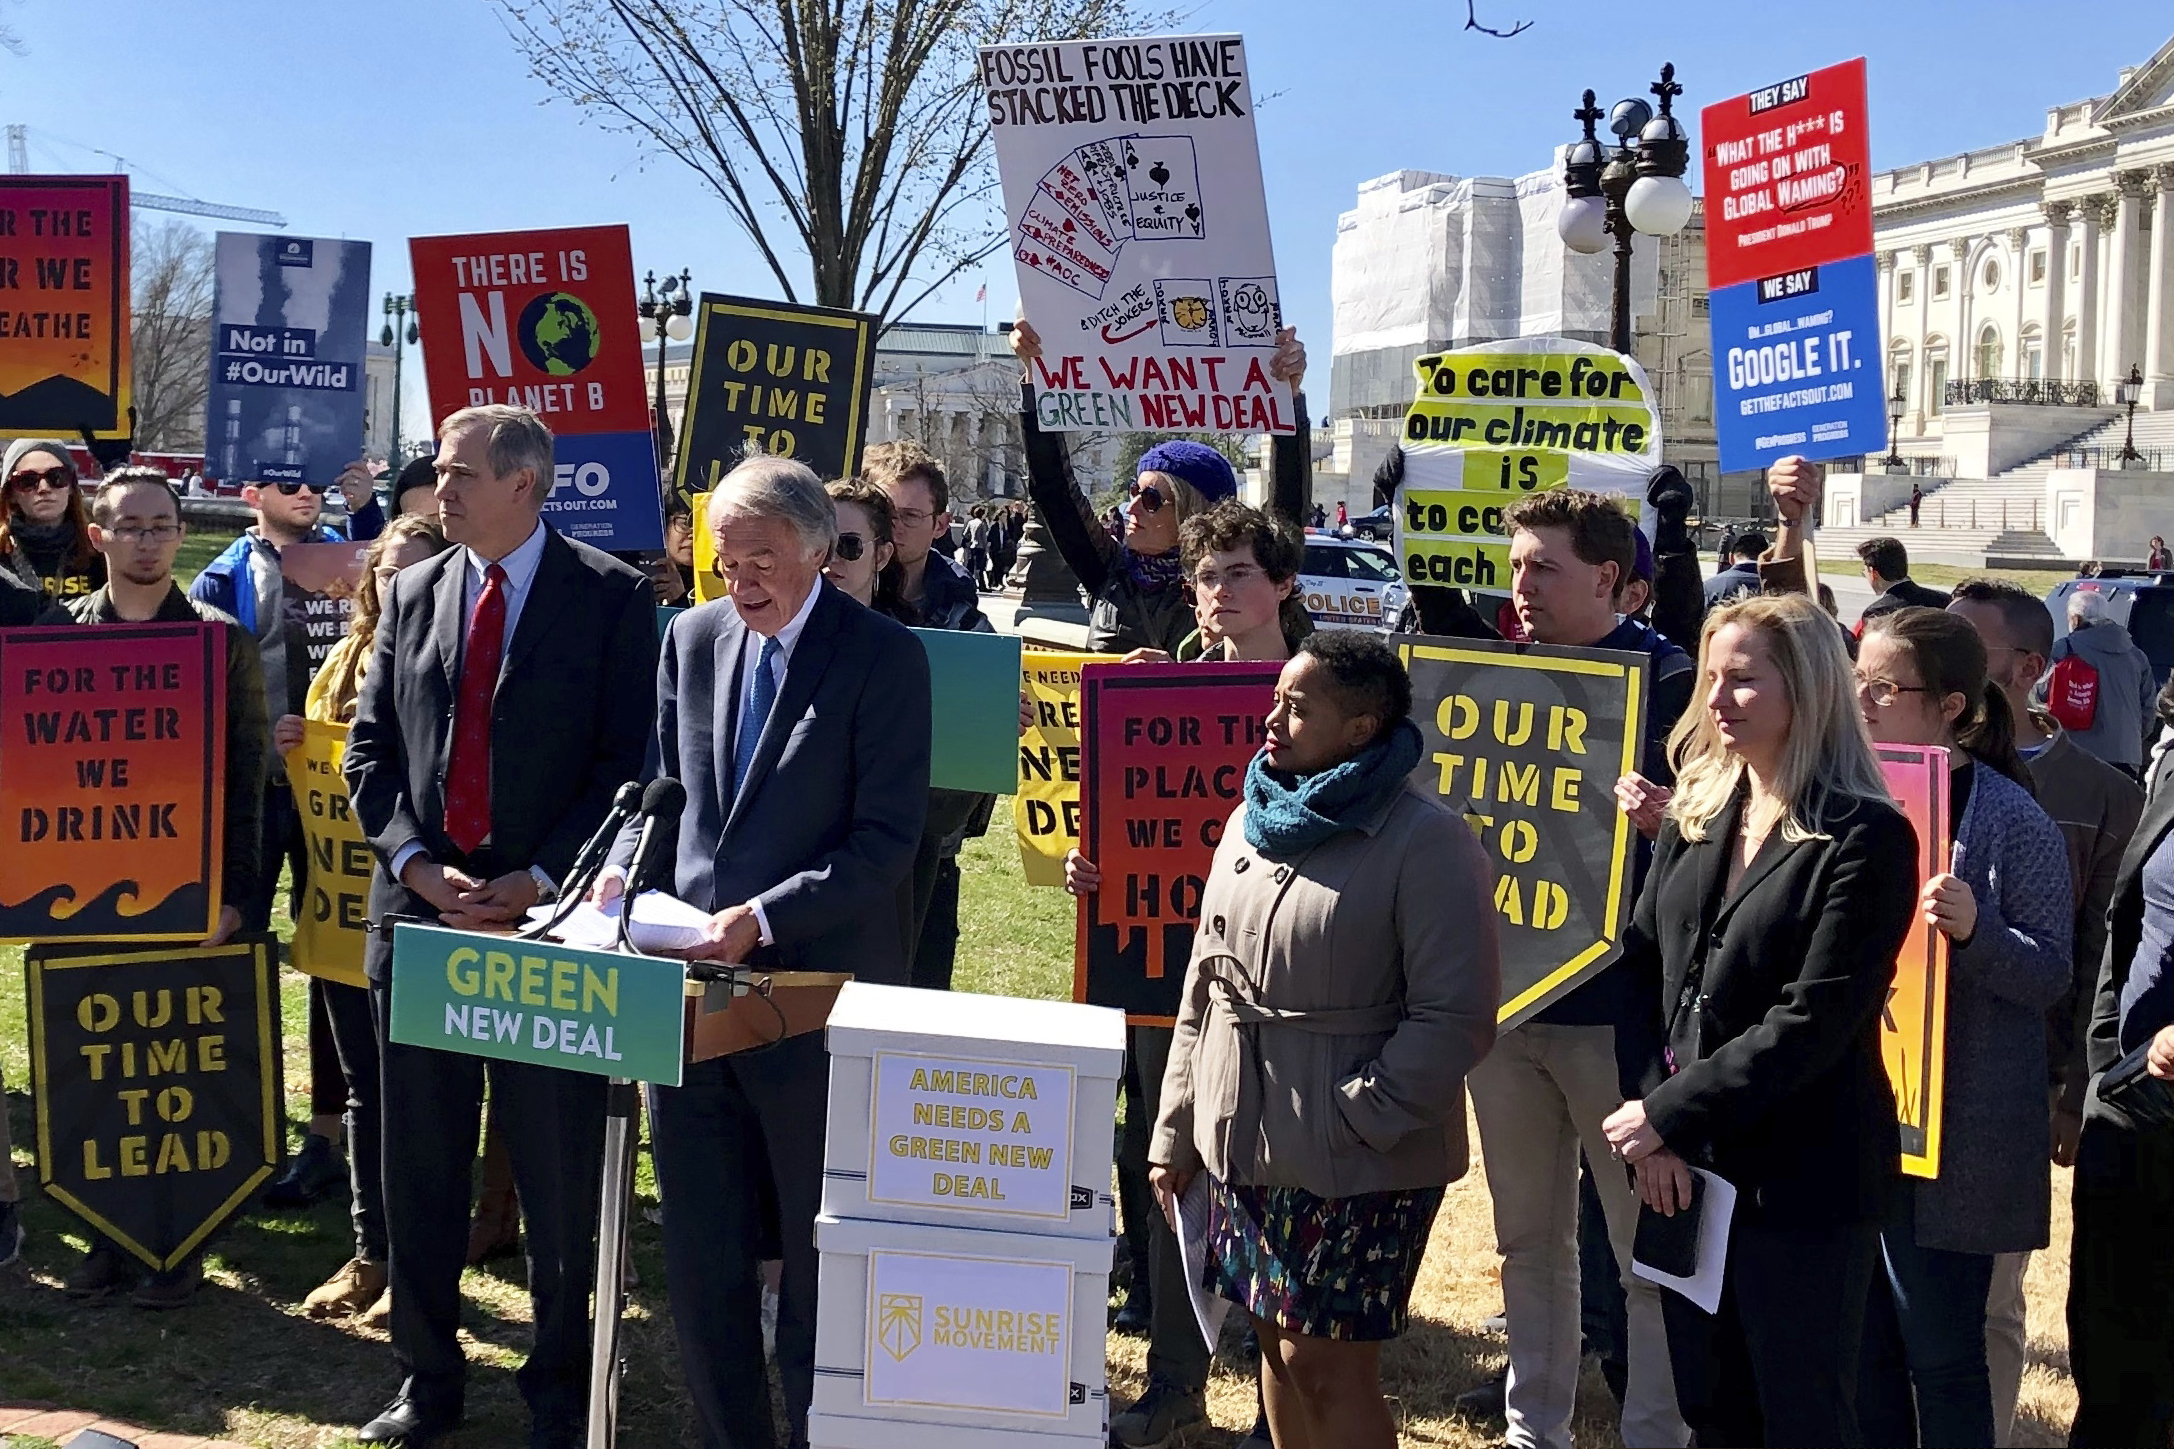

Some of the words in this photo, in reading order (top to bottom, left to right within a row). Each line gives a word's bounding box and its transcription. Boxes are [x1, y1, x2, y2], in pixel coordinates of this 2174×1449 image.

[980, 47, 1074, 87] FOSSIL
[1084, 44, 1164, 81] FOOLS
[1170, 40, 1242, 79] HAVE
[988, 85, 1106, 126] STACKED
[1108, 82, 1161, 125] THE
[1162, 80, 1246, 119] DECK
[1750, 85, 1780, 113] THEY
[1782, 76, 1809, 104] SAY
[1757, 128, 1784, 155] THE
[1829, 110, 1845, 136] IS
[1056, 164, 1081, 184] NET
[1730, 161, 1770, 192] GOING
[1772, 154, 1792, 179] ON
[1794, 143, 1832, 173] WITH
[1131, 191, 1186, 203] JUSTICE
[1723, 189, 1775, 222] GLOBAL
[29, 209, 92, 237] THE
[1028, 209, 1078, 246] CLIMATE
[1063, 198, 1114, 248] EMISSIONS
[1136, 216, 1185, 234] EQUITY
[36, 257, 92, 290] WE
[451, 251, 548, 288] THERE
[558, 249, 588, 281] IS
[1045, 254, 1081, 286] #AOC
[1763, 276, 1784, 299] WE
[1786, 271, 1812, 294] SAY
[1120, 283, 1146, 305] THE
[1114, 297, 1154, 332] JOKERS
[229, 329, 276, 352] Not
[283, 332, 306, 354] in
[225, 361, 348, 390] #OurWild
[727, 339, 832, 384] OUR
[1033, 356, 1091, 391] WE
[1098, 356, 1226, 392] WANT
[1242, 356, 1272, 395] A
[1419, 357, 1456, 395] To
[1467, 367, 1562, 398] care
[1570, 357, 1637, 399] for
[1727, 336, 1822, 391] GOOGLE
[1829, 330, 1863, 373] IT.
[587, 382, 604, 410] B
[723, 380, 827, 425] TIME
[1037, 391, 1134, 430] GREEN
[1139, 394, 1207, 429] NEW
[1214, 394, 1296, 432] DEAL
[1740, 381, 1854, 416] GETTHEFACTSOUT.COM
[742, 424, 796, 459] TO
[1407, 411, 1477, 442] our
[1485, 407, 1645, 454] climate
[1500, 455, 1538, 491] is
[1407, 495, 1448, 532] to
[1407, 546, 1496, 586] each
[305, 599, 333, 615] WE
[306, 622, 335, 637] WE
[24, 667, 96, 695] FOR
[111, 663, 181, 692] THE
[24, 706, 181, 745] WATER
[1124, 716, 1202, 746] FOR
[1436, 694, 1588, 754] OUR
[76, 758, 129, 789] WE
[307, 757, 329, 775] WE
[1432, 752, 1583, 813] TIME
[20, 802, 178, 843] DRINK
[1125, 818, 1183, 849] WE
[446, 947, 619, 1018] GREEN
[77, 986, 226, 1032] OUR
[444, 1002, 523, 1046] NEW
[532, 1015, 623, 1061] DEAL
[79, 1035, 227, 1081] TIME
[909, 1068, 1038, 1101] AMERICA
[118, 1086, 194, 1126] TO
[913, 1103, 1005, 1133] NEEDS
[1011, 1110, 1031, 1134] A
[83, 1130, 231, 1181] LEAD
[889, 1134, 981, 1165] GREEN
[988, 1144, 1055, 1171] NEW
[933, 1173, 1006, 1201] DEAL
[934, 1305, 1061, 1338] SUNRISE
[933, 1332, 1060, 1356] MOVEMENT
